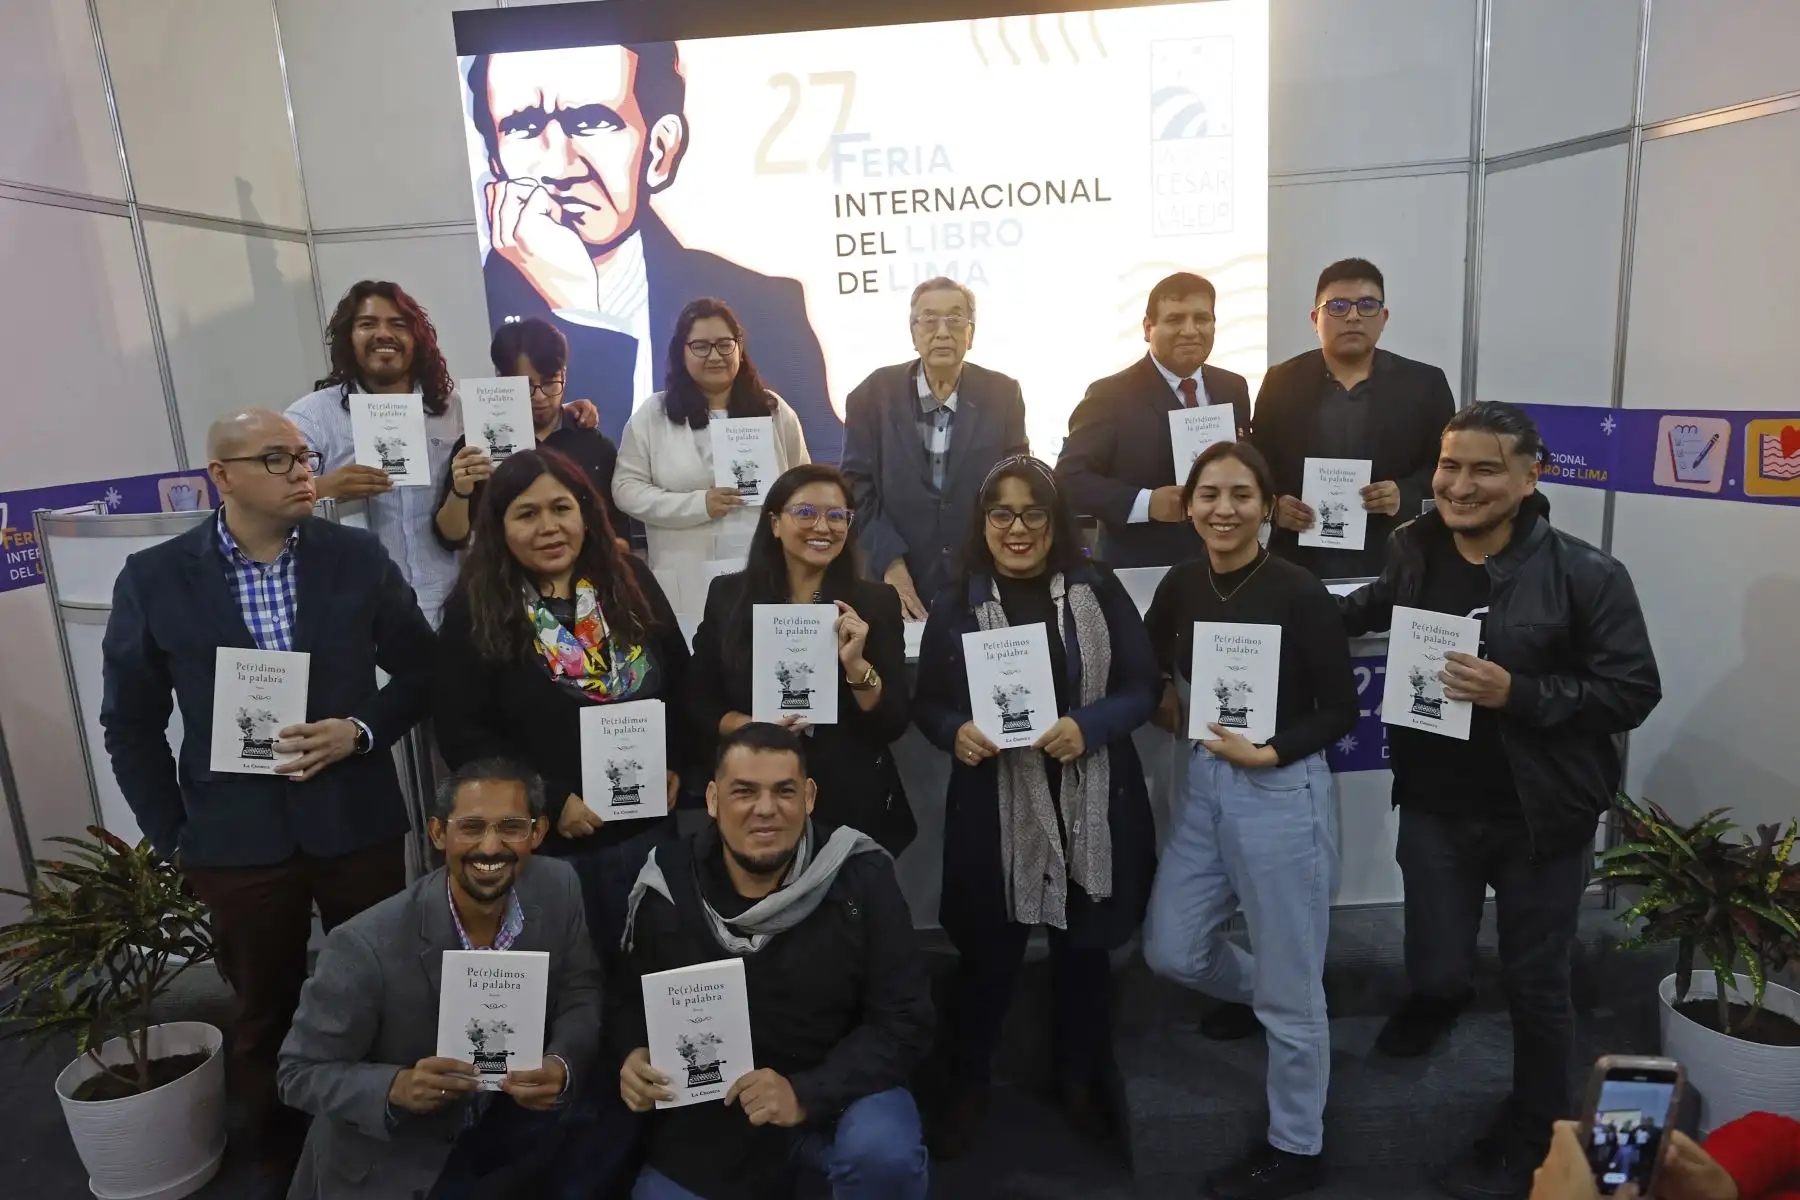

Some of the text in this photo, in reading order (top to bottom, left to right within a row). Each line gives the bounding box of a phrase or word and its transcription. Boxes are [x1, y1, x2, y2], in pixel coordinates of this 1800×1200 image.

[754, 71, 857, 176] 27
[830, 132, 954, 184] FERIA
[834, 177, 1112, 218] INTERNACIONAL
[836, 219, 1023, 257] DEL LIBRO
[838, 271, 879, 295] DE
[1562, 467, 1576, 478] DE
[1577, 468, 1608, 482] LIMA
[9, 566, 35, 580] DEL
[773, 617, 820, 626] Pe(r)dimos
[775, 627, 818, 637] la palabra
[1412, 621, 1460, 638] Pe(r)dimos
[1214, 634, 1262, 646] Pe(r)dimos
[1413, 631, 1456, 647] la palabra
[986, 648, 1028, 660] la palabra
[1216, 644, 1258, 655] la palabra
[236, 661, 286, 674] Pe(r)dimos
[238, 672, 283, 683] la palabra
[603, 726, 645, 736] la palabra
[467, 967, 525, 979] Pe(r)dimos
[469, 979, 521, 990] la palabra
[668, 983, 725, 996] Pe(r)dimos
[672, 993, 722, 1007] la palabra
